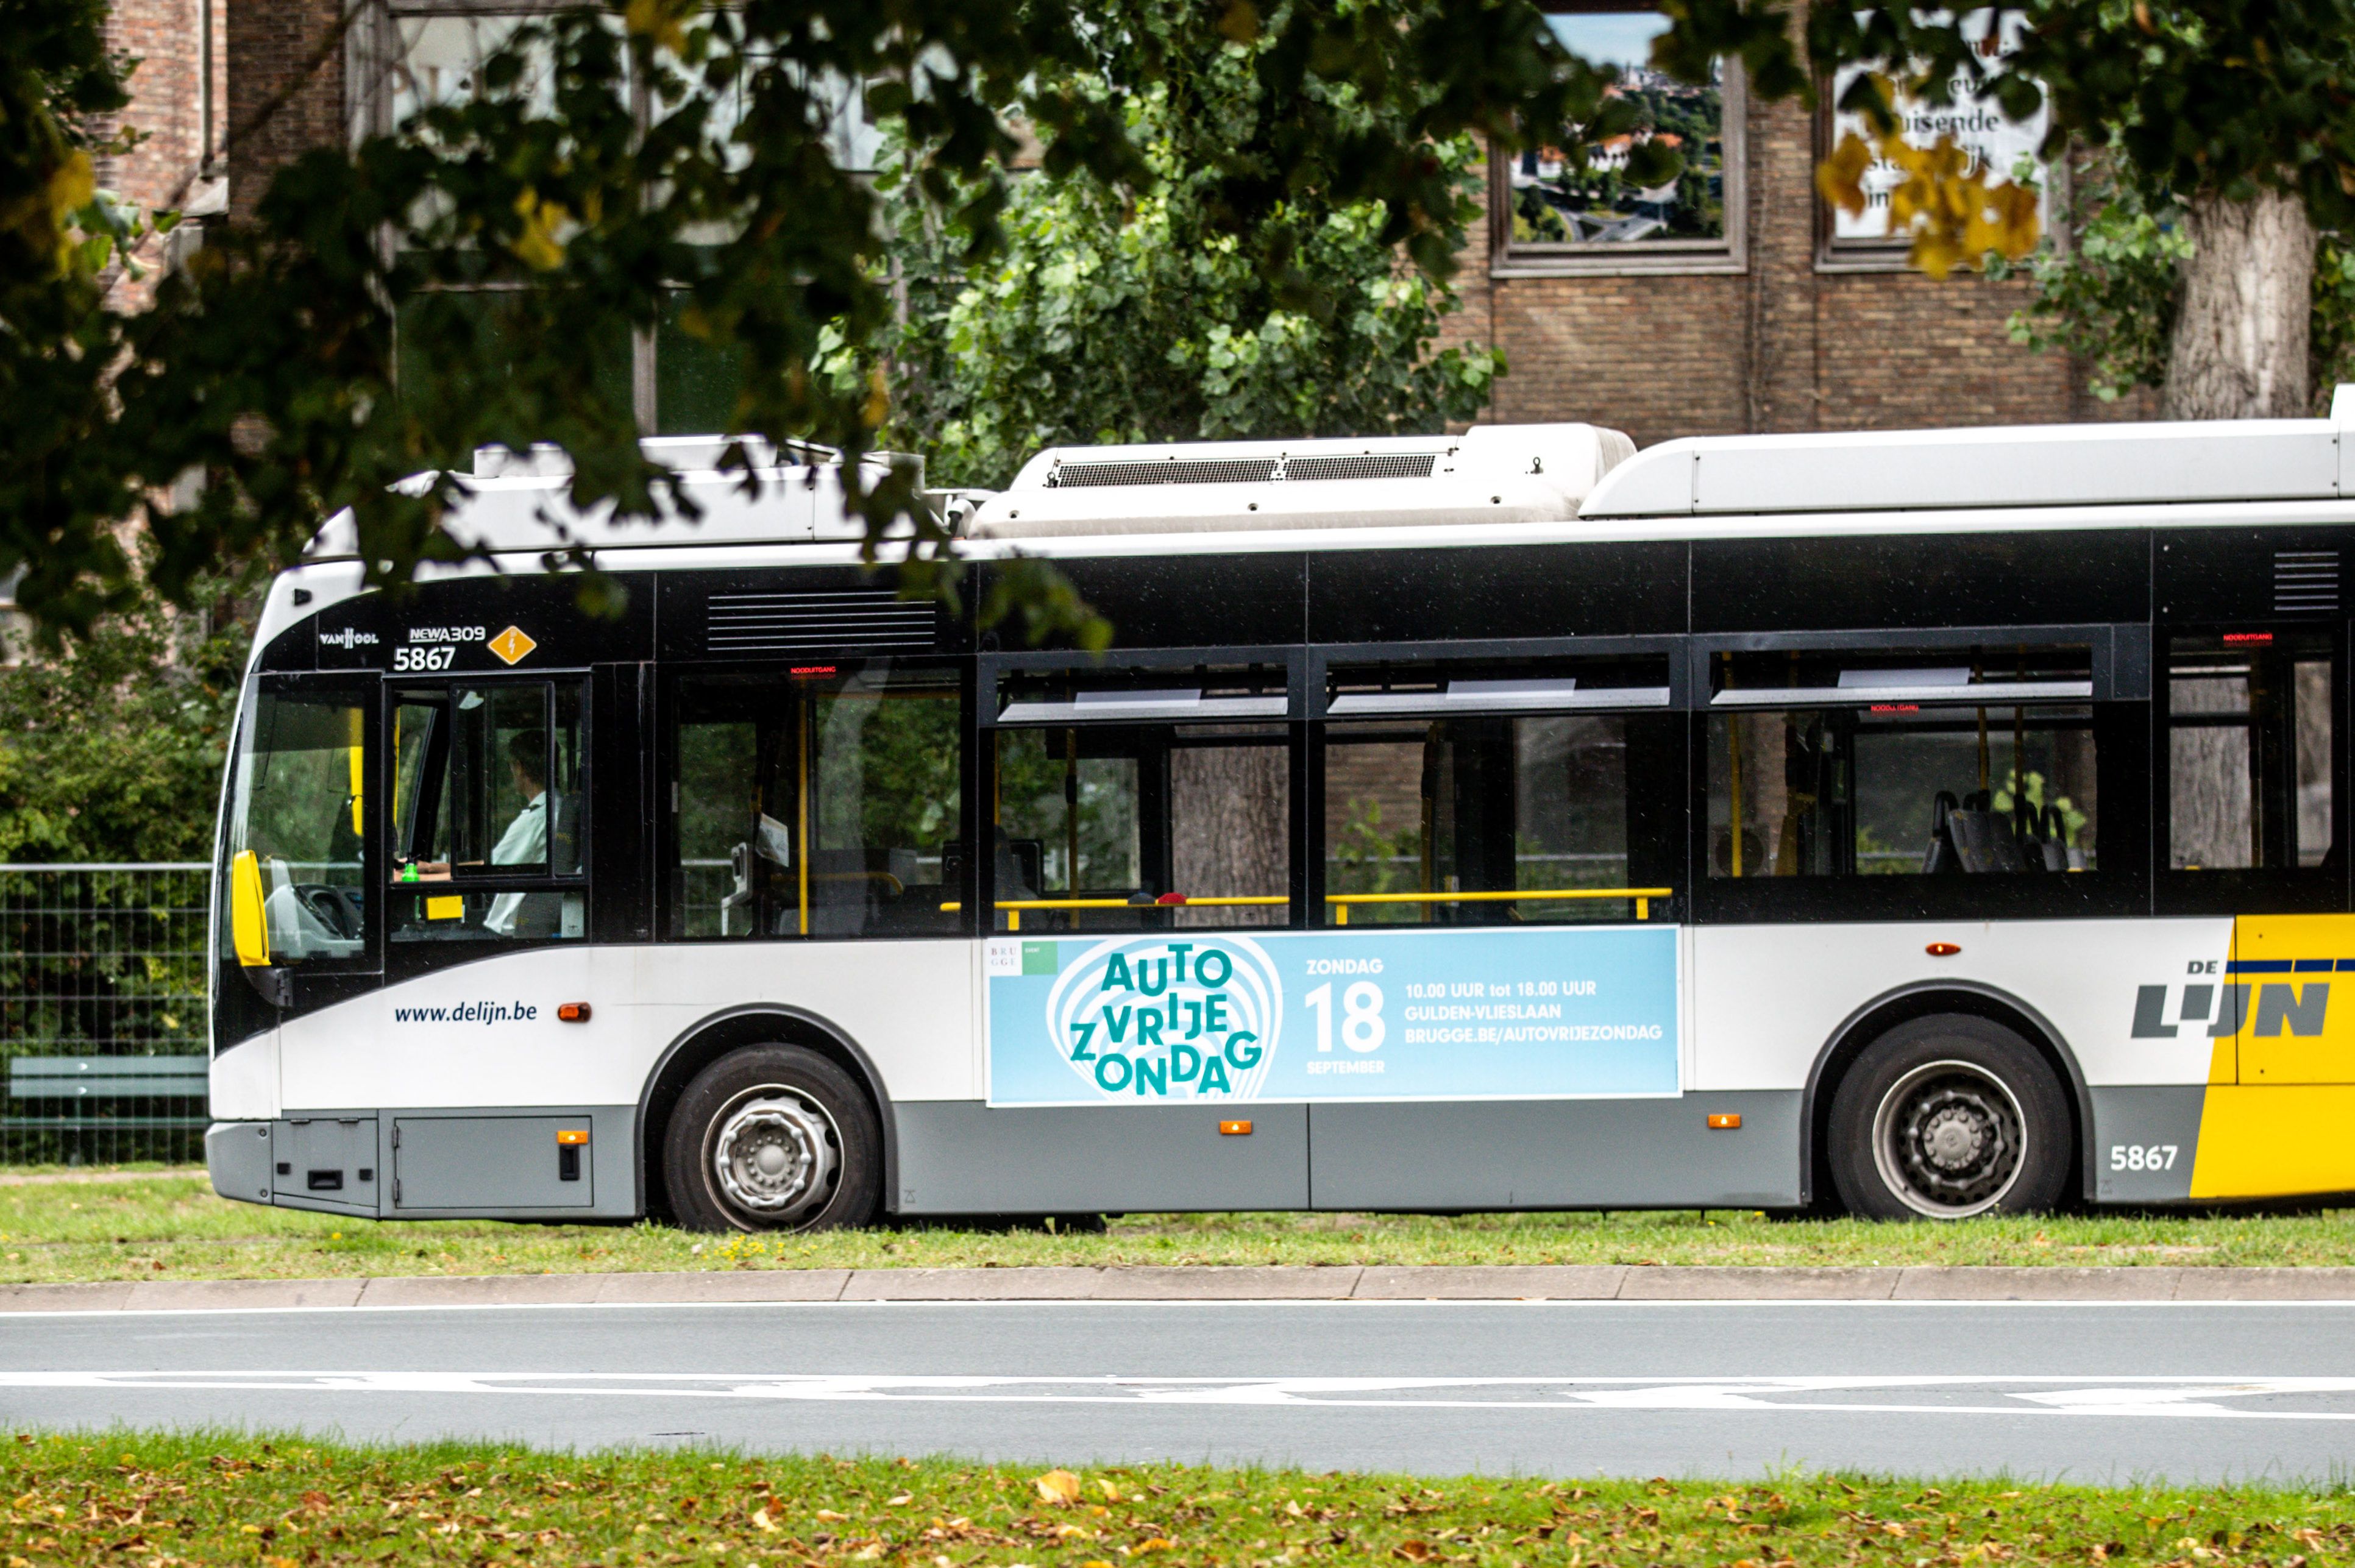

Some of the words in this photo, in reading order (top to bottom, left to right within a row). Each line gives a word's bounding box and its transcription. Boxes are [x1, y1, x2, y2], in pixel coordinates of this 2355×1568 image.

[394, 647, 456, 670] 5867
[1101, 944, 1232, 996] AUTO
[1307, 959, 1384, 975] ZONDAG
[2187, 960, 2218, 974] DE
[1406, 983, 1446, 998] 10.00
[1451, 982, 1484, 998] UUR
[1490, 984, 1511, 997] tot
[1518, 982, 1557, 996] 18.00
[1563, 981, 1596, 996] UUR
[395, 1001, 537, 1025] www.delijn.be
[1103, 993, 1227, 1045] VRIJE
[1305, 981, 1386, 1054] 18
[1404, 1004, 1561, 1021] GULDEN-VLIESLAAN
[2130, 983, 2330, 1039] LIJN
[1405, 1025, 1663, 1045] BRUGGE.BE/AUTOVRIJEZONDAG
[1070, 1023, 1262, 1095] ZONDAG
[1307, 1060, 1385, 1076] SEPTEMBER
[2111, 1146, 2178, 1171] 5867
